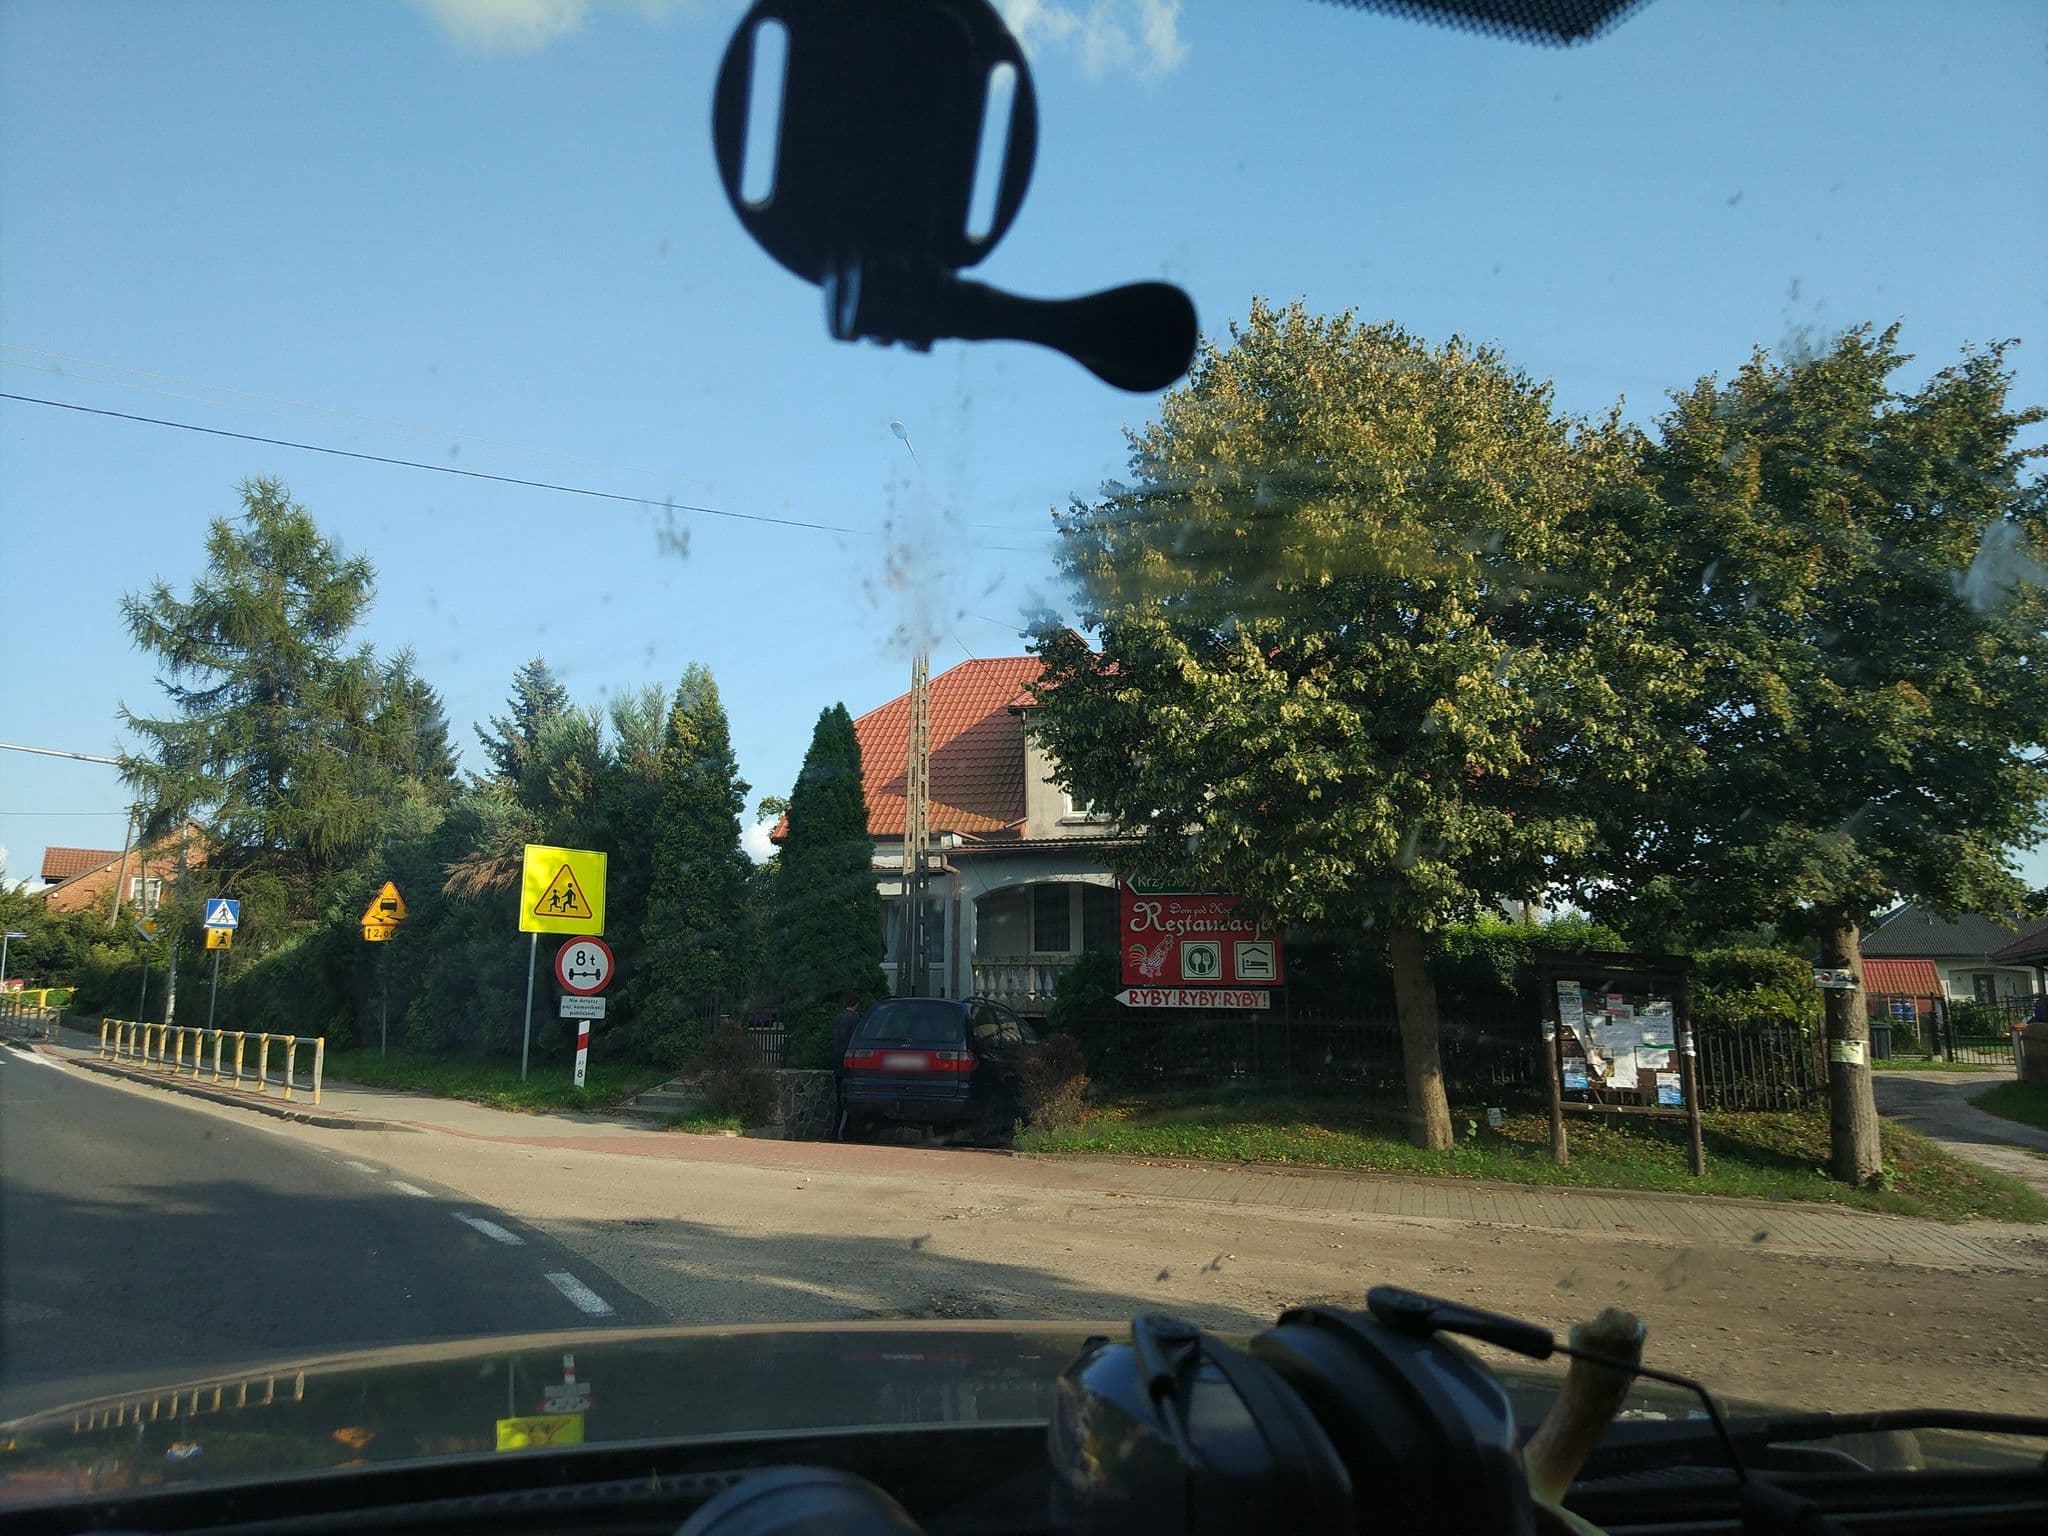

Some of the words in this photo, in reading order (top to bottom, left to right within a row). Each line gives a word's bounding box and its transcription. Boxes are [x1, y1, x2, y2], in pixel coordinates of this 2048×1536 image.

[1169, 903, 1192, 914] Dom
[1193, 905, 1207, 917] pod
[575, 950, 586, 966] 8
[589, 954, 596, 966] t
[577, 1069, 584, 1078] 8
